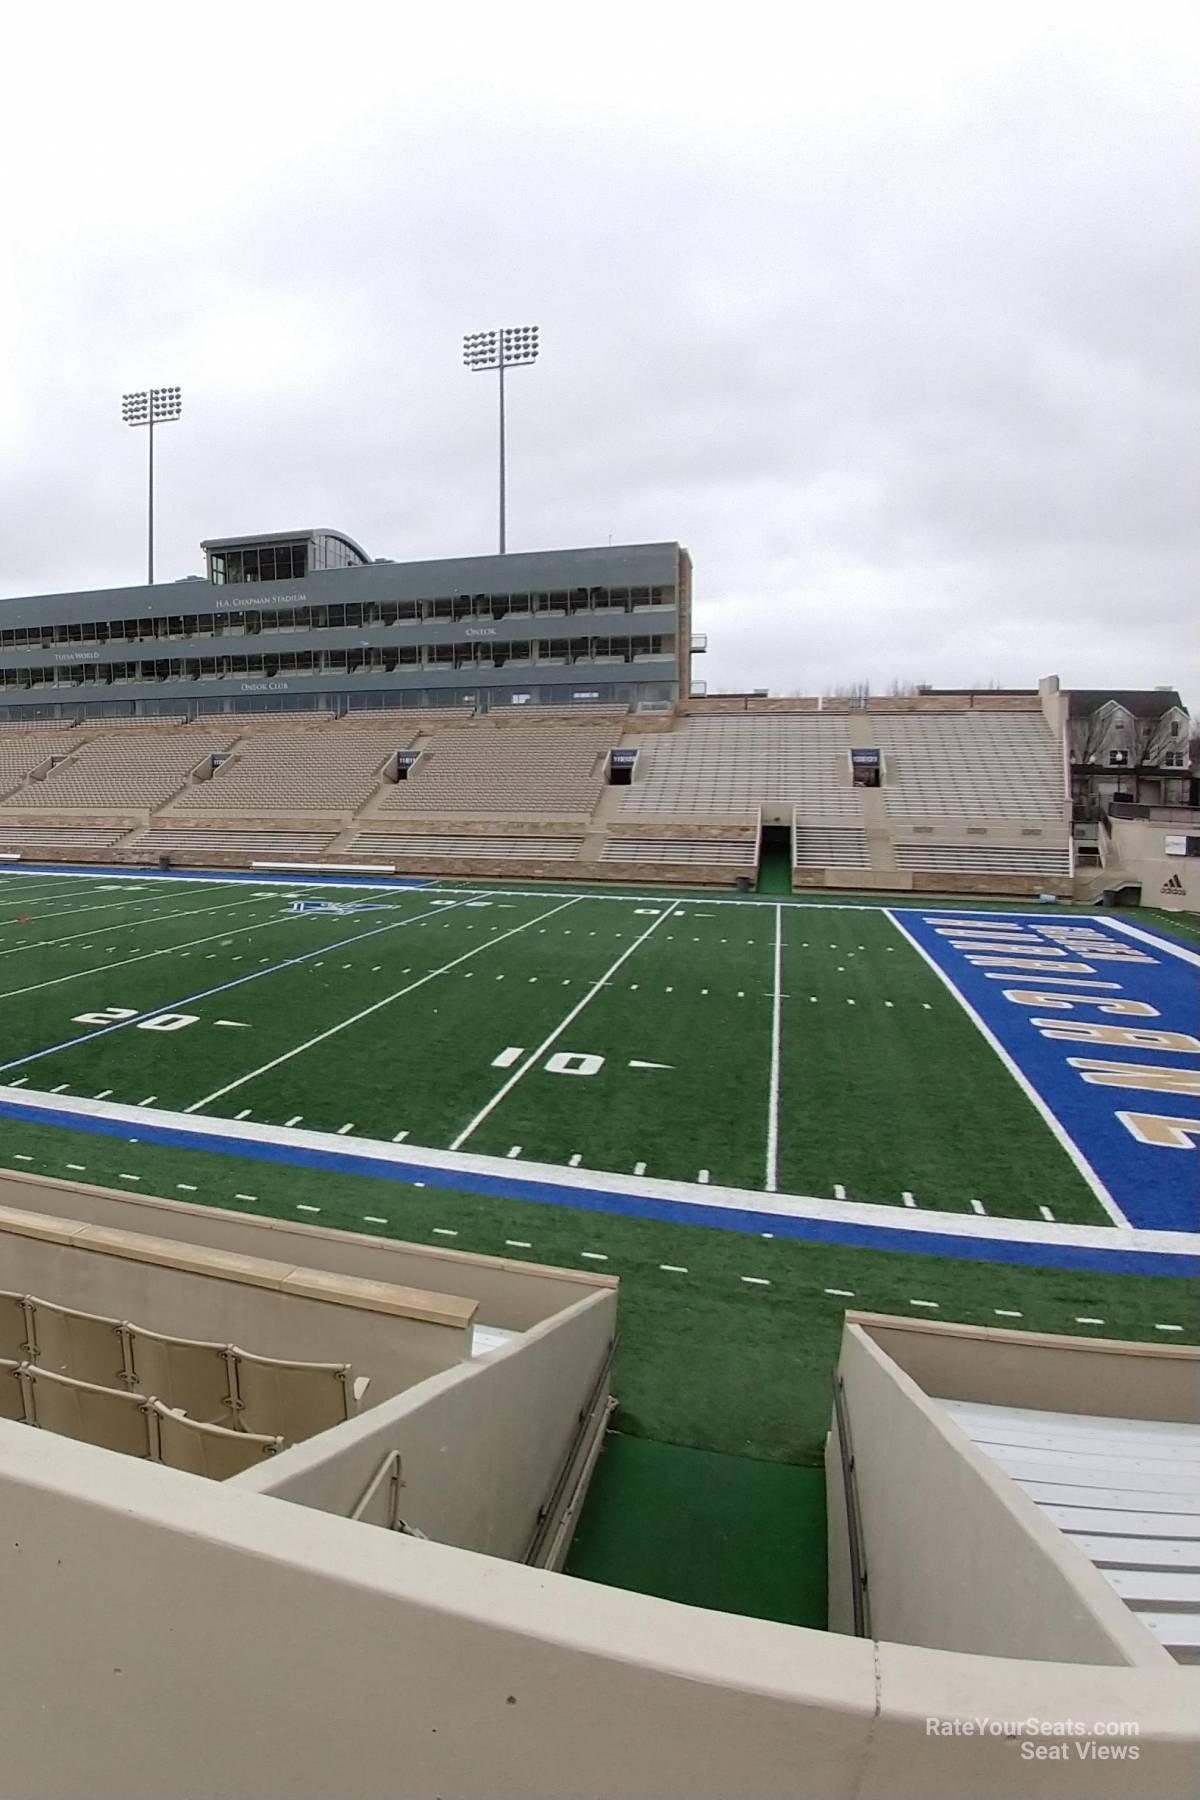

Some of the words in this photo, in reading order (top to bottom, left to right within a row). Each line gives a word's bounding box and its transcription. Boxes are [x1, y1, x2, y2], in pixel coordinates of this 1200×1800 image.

[272, 593, 307, 603] STADIUM
[1160, 887, 1186, 896] adidas
[70, 1007, 200, 1031] 20
[490, 1047, 606, 1076] 10
